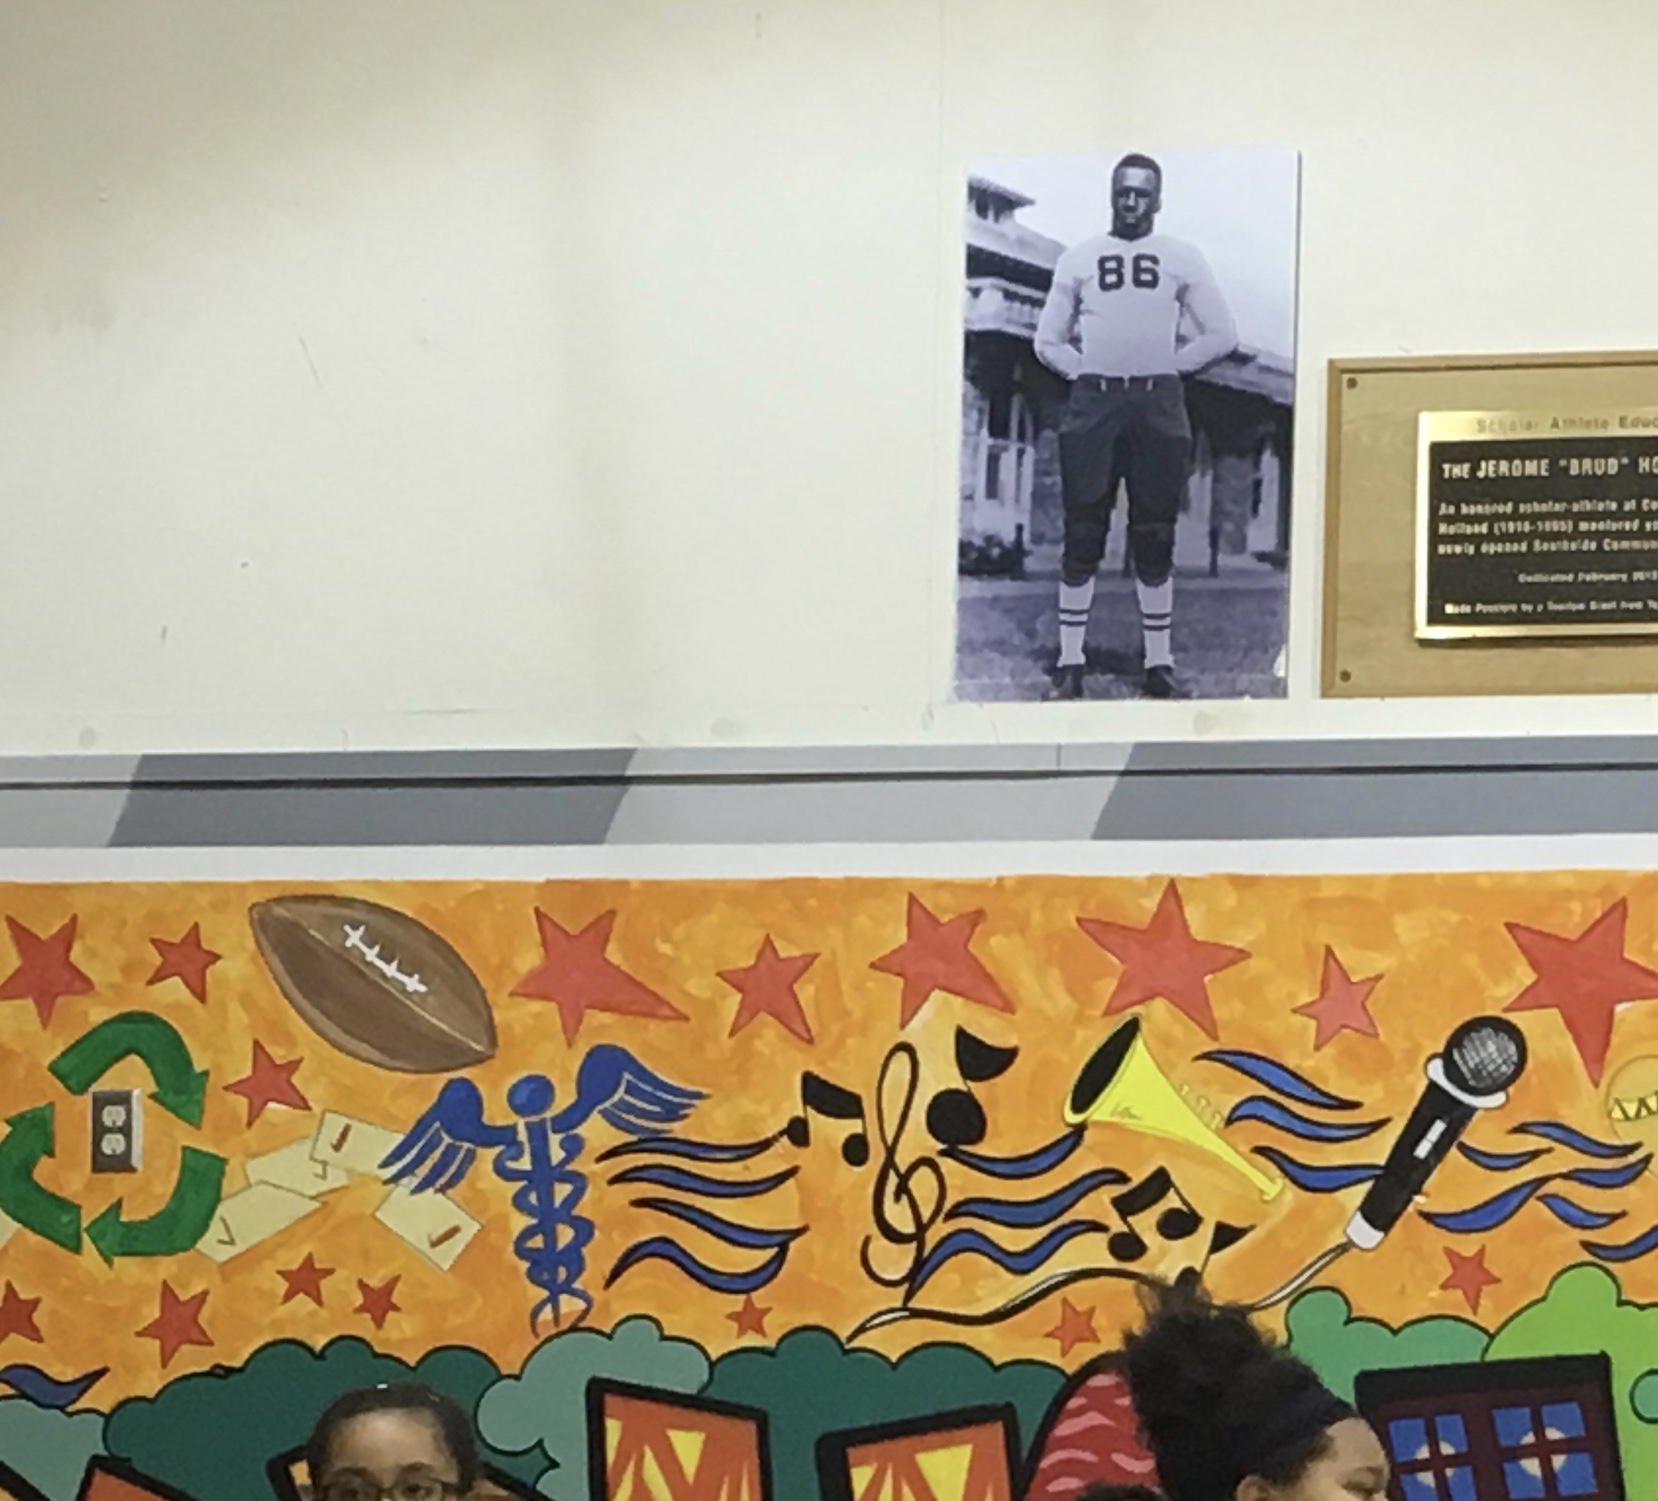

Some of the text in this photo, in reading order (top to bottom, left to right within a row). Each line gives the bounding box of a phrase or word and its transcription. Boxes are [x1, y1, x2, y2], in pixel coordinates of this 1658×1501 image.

[1097, 253, 1160, 291] 86
[1441, 463, 1471, 479] THE
[1476, 457, 1550, 479] JEROME
